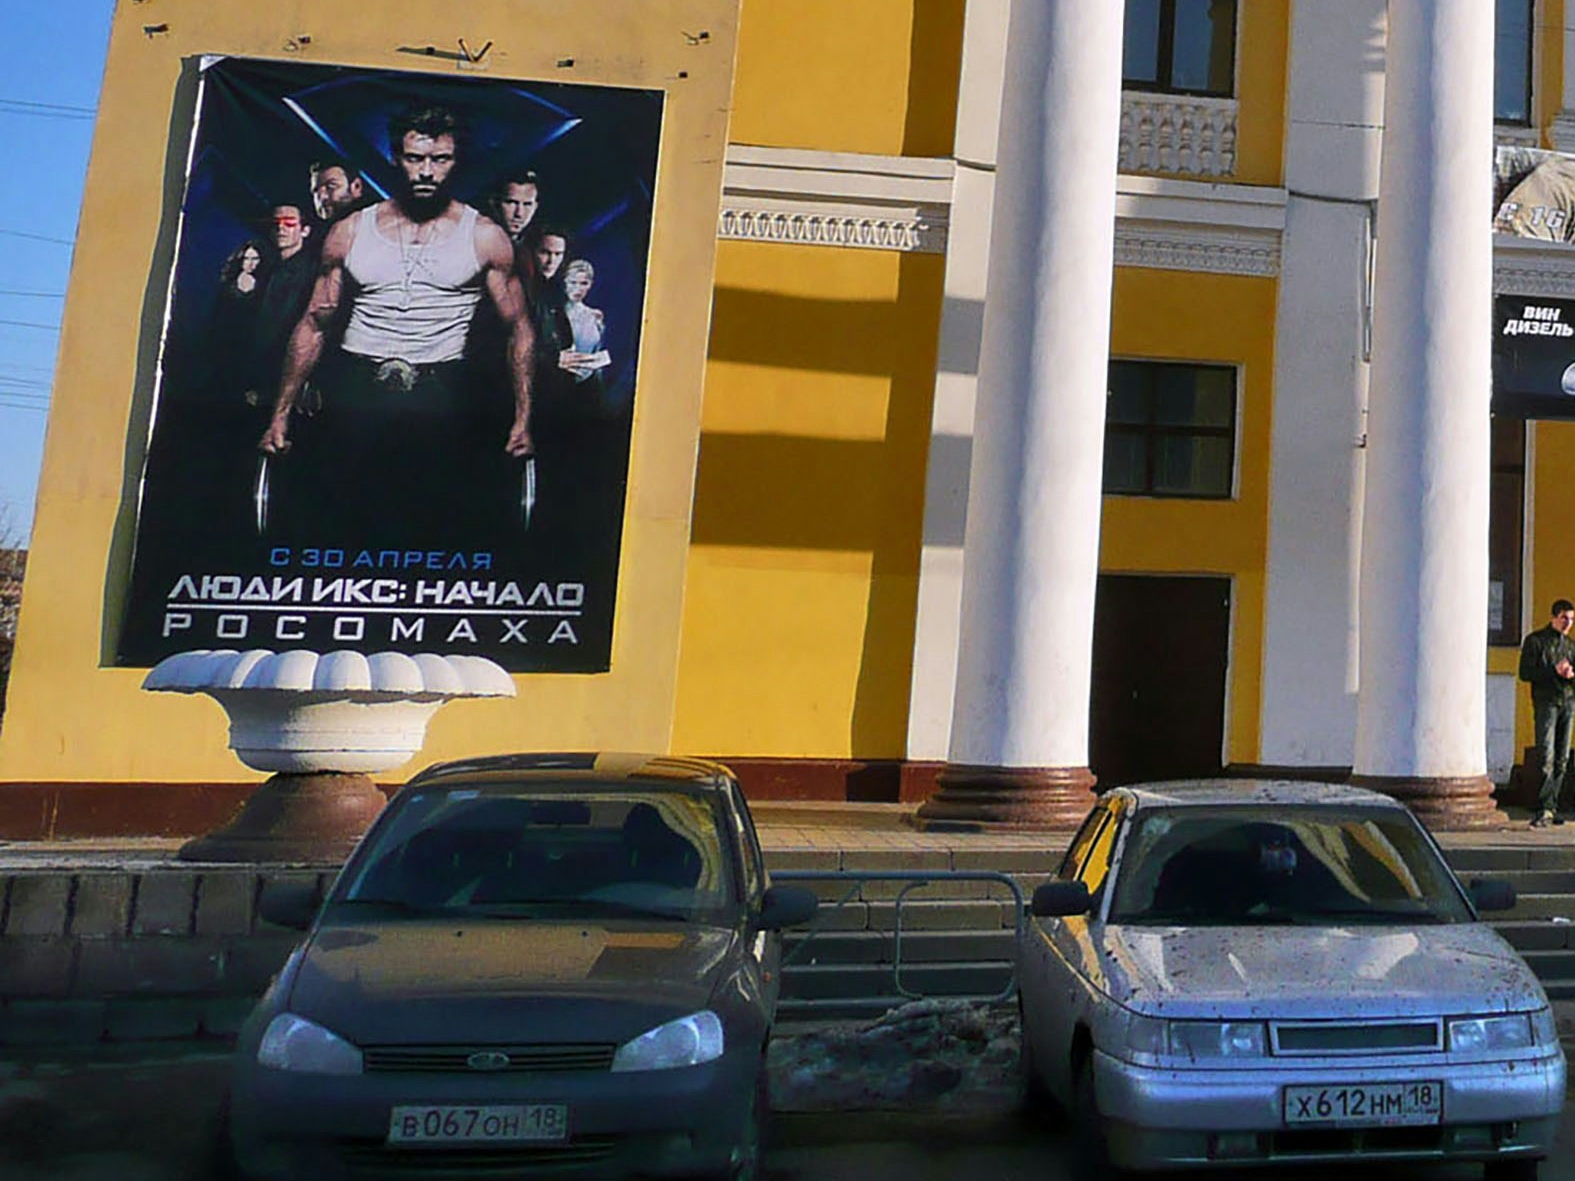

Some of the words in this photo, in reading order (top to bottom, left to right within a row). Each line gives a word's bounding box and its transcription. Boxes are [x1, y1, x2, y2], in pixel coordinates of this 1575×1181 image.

[1499, 201, 1519, 221] С
[1531, 205, 1566, 229] 16
[1523, 306, 1561, 321] ВИН
[1503, 319, 1574, 337] ДИЗЕЛЬ
[270, 547, 291, 566] С
[301, 548, 345, 568] 30
[352, 550, 493, 570] АПРЕЛЯ
[168, 576, 303, 602] ЛЮДИ
[311, 578, 407, 604] ИКС:
[415, 581, 585, 607] НАЧАЛО
[162, 613, 579, 645] РОСОМАХА
